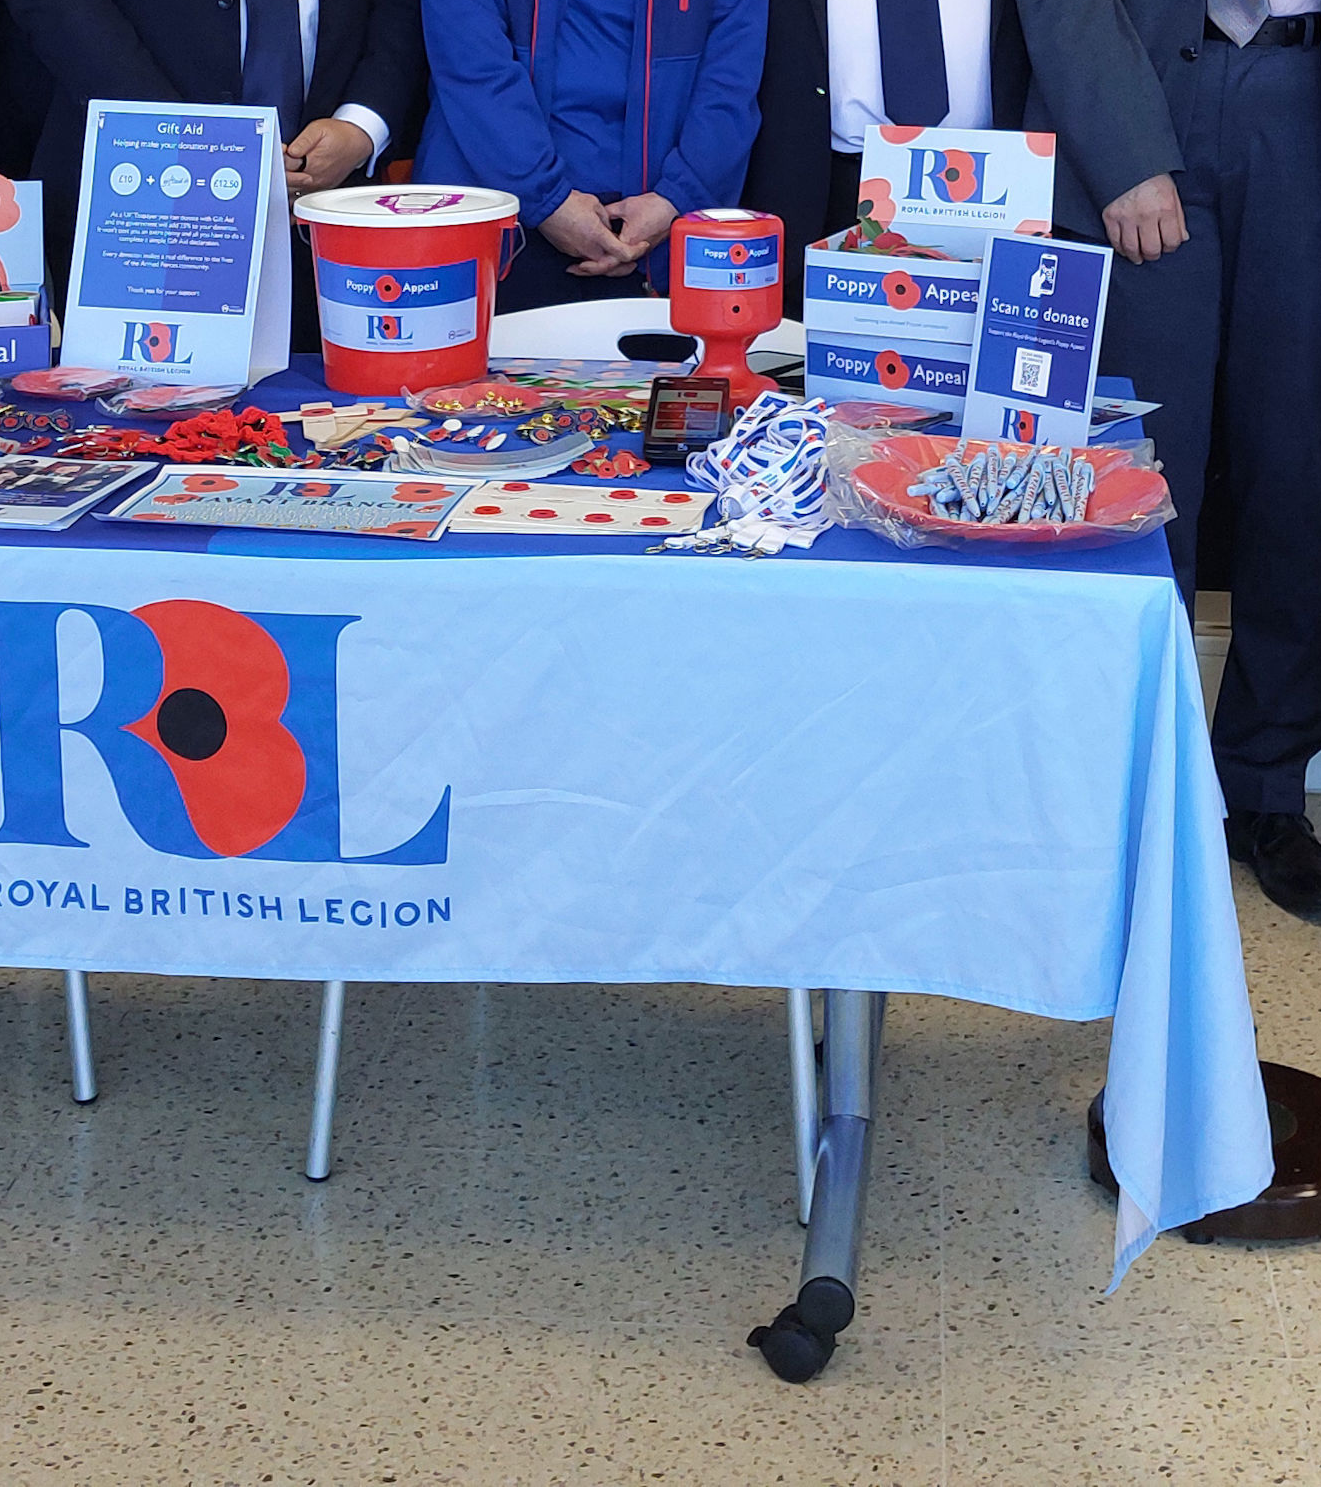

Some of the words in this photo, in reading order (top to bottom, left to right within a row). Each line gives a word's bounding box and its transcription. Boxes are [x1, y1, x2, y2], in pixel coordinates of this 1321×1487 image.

[157, 122, 180, 134] Gift
[182, 123, 204, 135] Aid
[160, 143, 177, 151] your
[178, 142, 208, 151] donation
[220, 144, 246, 153] further
[118, 174, 133, 184] £10
[214, 178, 239, 189] £12.50
[901, 206, 929, 215] ROYAL
[932, 207, 969, 217] BRITISH
[971, 210, 1006, 220] LEGION
[704, 248, 728, 259] Poppy
[748, 246, 769, 258] Appeal
[346, 279, 374, 295] Poppy
[402, 280, 439, 296] Appeal
[827, 273, 878, 298] Poppy
[925, 283, 979, 305] Appea
[991, 297, 1020, 317] Scan
[1024, 305, 1039, 319] to
[1043, 307, 1090, 329] donate
[827, 351, 871, 375] Poppy
[913, 364, 967, 387] Appeal
[300, 498, 417, 511] BRANCH
[124, 885, 283, 923] BRITISH
[298, 896, 451, 929] LEGION
